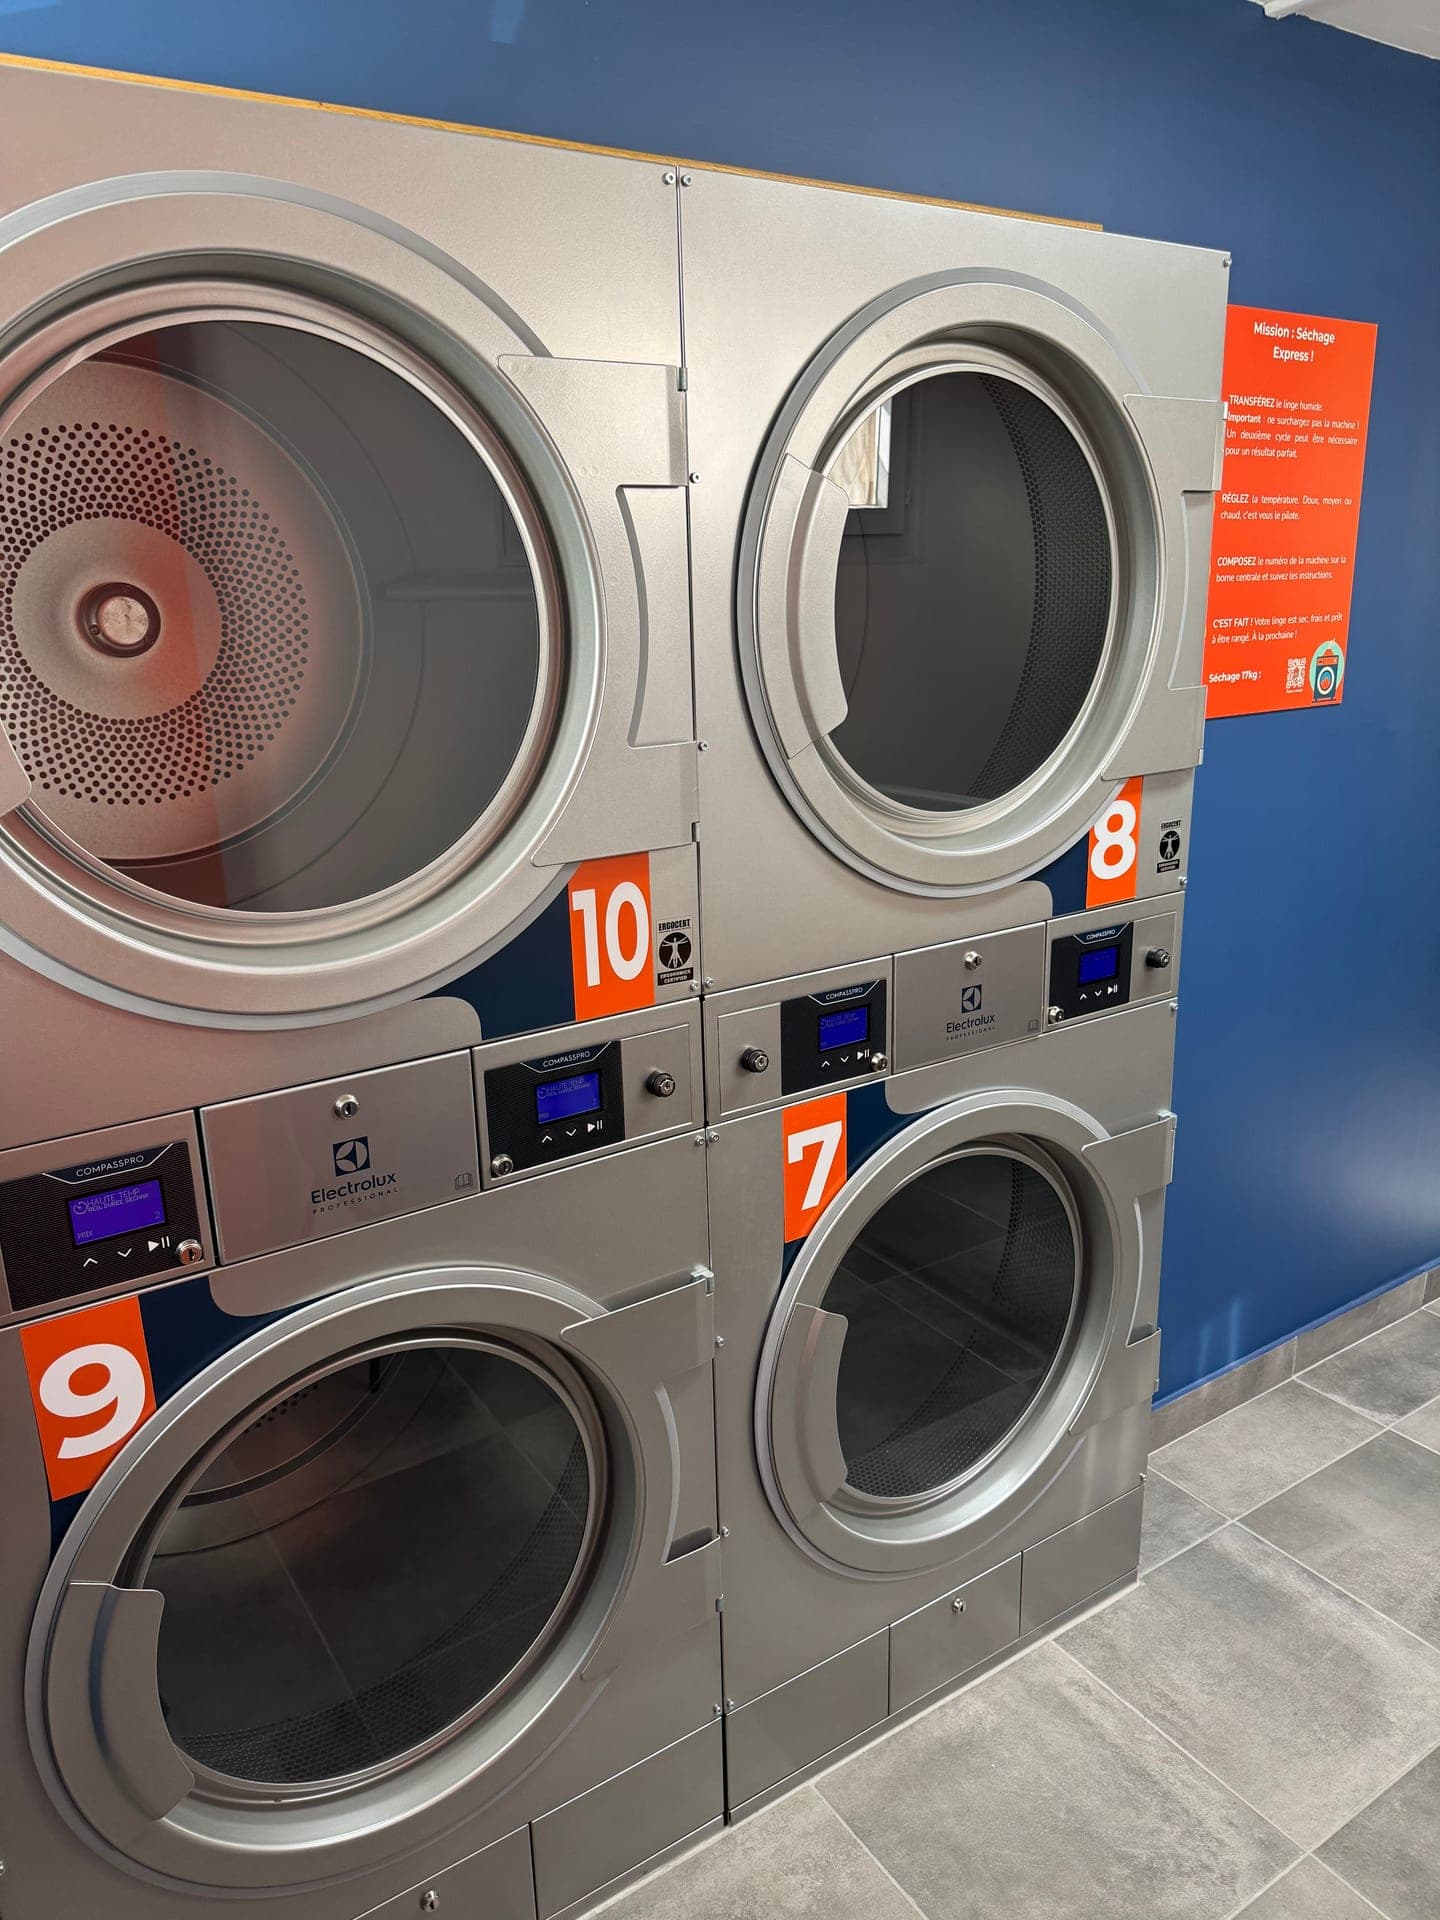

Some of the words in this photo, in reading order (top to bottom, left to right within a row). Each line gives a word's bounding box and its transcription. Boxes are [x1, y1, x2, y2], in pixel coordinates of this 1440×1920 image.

[1254, 322, 1289, 338] Mission
[1296, 328, 1335, 345] Séchage
[1273, 346, 1309, 362] Express
[1229, 394, 1274, 408] TRANSFÉREZ
[1276, 400, 1282, 409] le
[1283, 400, 1298, 411] linge
[1228, 412, 1261, 424] Important
[1277, 417, 1309, 428] surchargez
[1311, 420, 1322, 429] pas
[1324, 418, 1330, 427] la
[1332, 419, 1355, 430] machine
[1226, 429, 1236, 439] Un
[1240, 430, 1271, 440] deuxième
[1276, 430, 1291, 442] cycle
[1295, 433, 1309, 443] peut
[1312, 433, 1325, 444] être
[1328, 436, 1358, 445] nécessaire
[1225, 447, 1240, 457] pour
[1242, 448, 1250, 456] un
[1252, 446, 1275, 457] résultat
[1222, 492, 1249, 504] RÉGLEZ
[1252, 495, 1258, 504] la
[1262, 494, 1299, 505] température.
[1323, 496, 1342, 507] moyen
[1259, 512, 1273, 520] vous
[1274, 511, 1281, 520] le
[1217, 556, 1256, 567] COMPOSEZ
[1258, 557, 1264, 565] le
[1265, 557, 1288, 566] numéro
[1289, 556, 1297, 565] de
[1298, 556, 1305, 564] la
[1306, 556, 1329, 565] machine
[1330, 556, 1339, 564] sur
[1341, 555, 1346, 564] la
[1216, 573, 1234, 582] borne
[1236, 572, 1260, 582] centrale
[1262, 572, 1269, 581] et
[1270, 572, 1288, 582] suivez
[1289, 571, 1298, 580] les
[1213, 618, 1232, 628] C'EST
[1234, 617, 1249, 627] FAIT
[1254, 617, 1270, 626] Votre
[1272, 616, 1286, 627] linge
[1288, 616, 1297, 624] est
[1311, 614, 1323, 622] frais
[1324, 614, 1330, 622] et
[1331, 612, 1343, 624] prêt
[1217, 634, 1230, 643] être
[1252, 630, 1257, 641] À
[1258, 632, 1264, 641] la
[1265, 631, 1294, 642] prochaine
[1209, 671, 1240, 683] Séchage
[1241, 670, 1258, 680] 17kg
[1090, 799, 1137, 880] 8
[571, 881, 650, 988] 10
[826, 987, 863, 1000] COMPASSPRO
[947, 1014, 995, 1033] Electrolux
[542, 1051, 590, 1068] COMPASSPRO
[76, 1155, 144, 1177] COMPASSPRO
[787, 1120, 843, 1210] 7
[311, 1173, 397, 1204] Electrolux
[312, 1187, 398, 1215] PROFESSIONAL
[39, 1343, 146, 1459] 9
